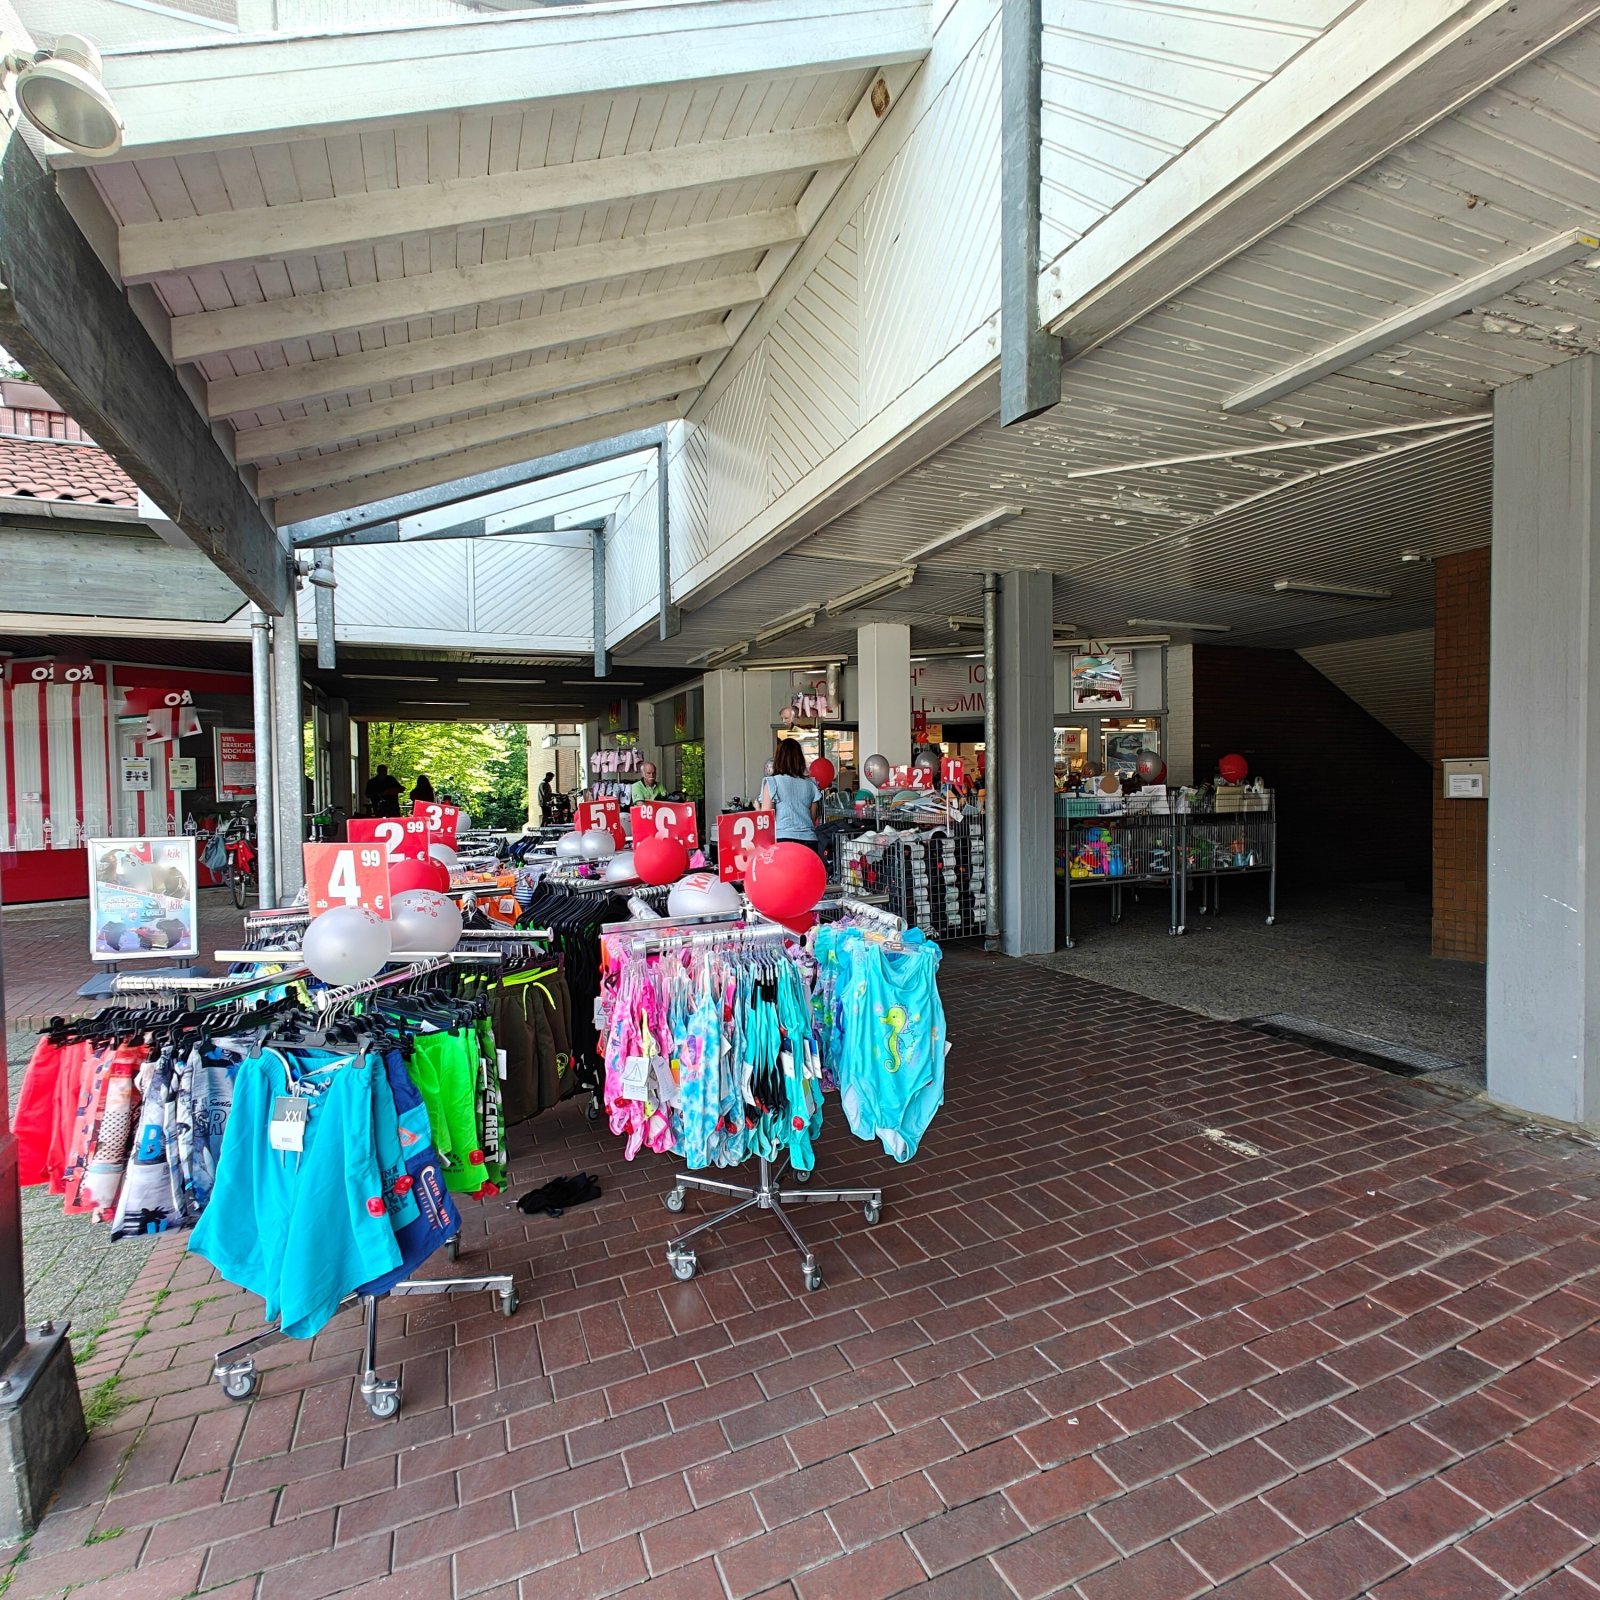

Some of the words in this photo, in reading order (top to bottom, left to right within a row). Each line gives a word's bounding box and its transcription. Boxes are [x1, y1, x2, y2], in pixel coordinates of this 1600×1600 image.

[444, 807, 455, 816] 99
[756, 814, 770, 830] 99
[406, 821, 424, 834] 99
[416, 851, 425, 861] €
[316, 899, 328, 909] ab
[360, 850, 381, 868] 99
[374, 895, 385, 910] €
